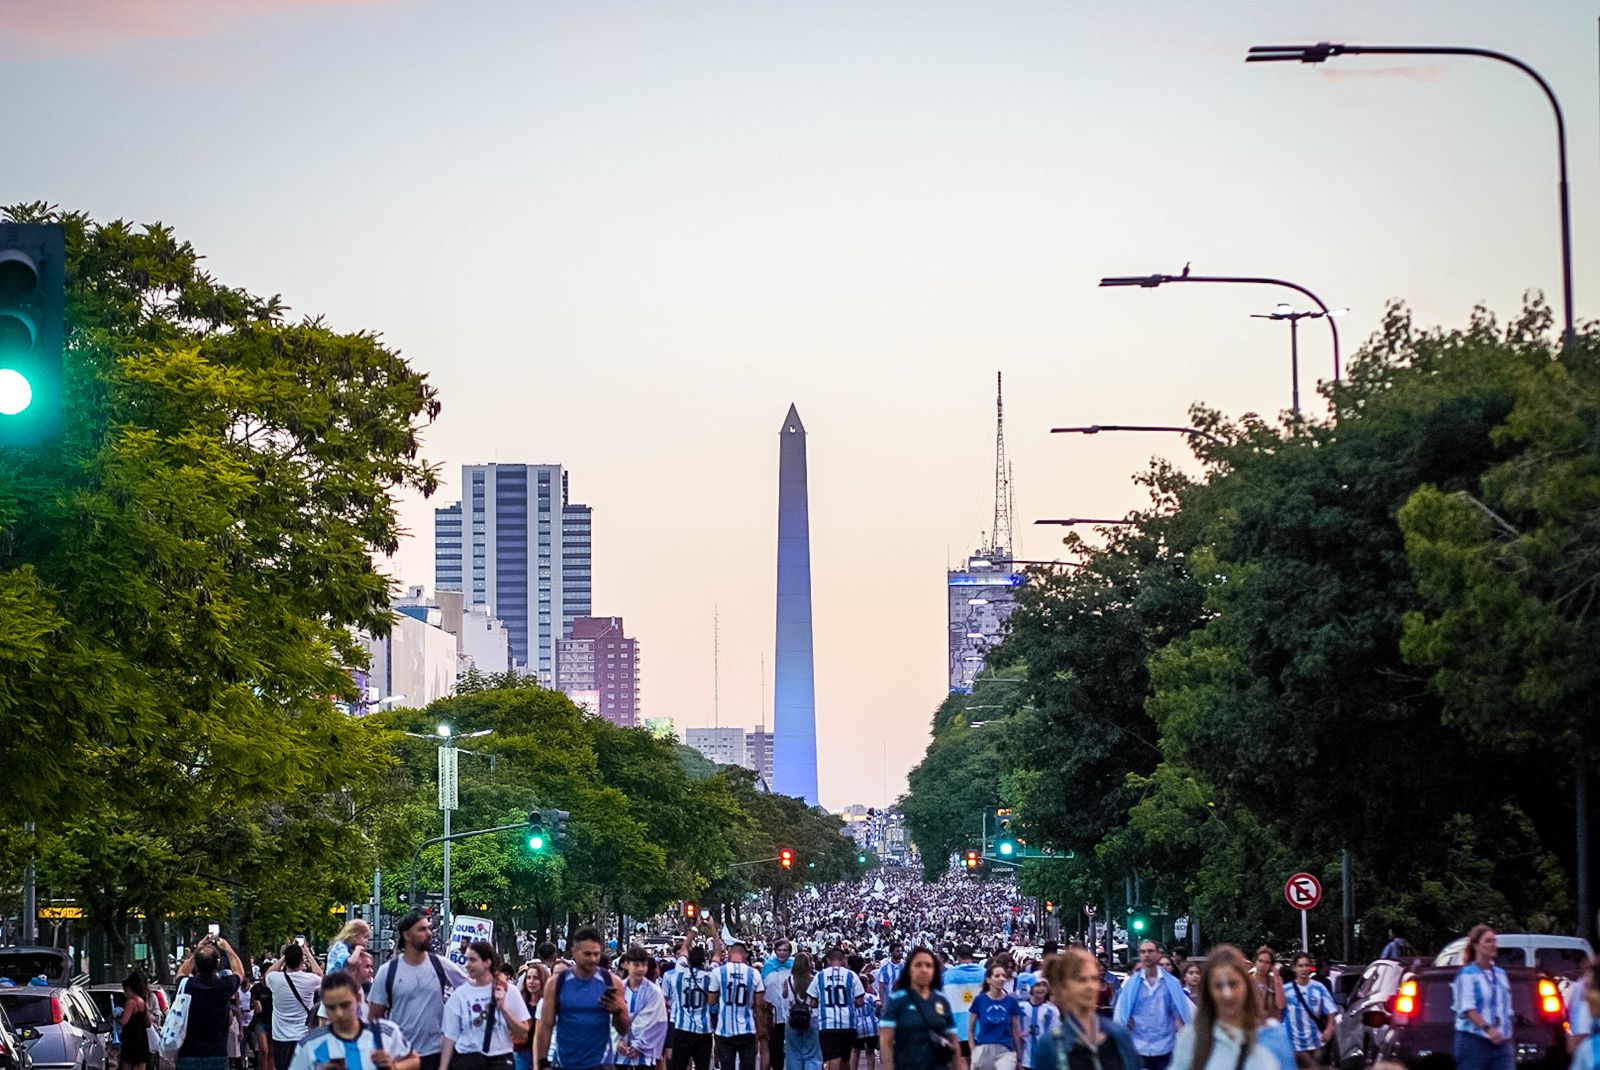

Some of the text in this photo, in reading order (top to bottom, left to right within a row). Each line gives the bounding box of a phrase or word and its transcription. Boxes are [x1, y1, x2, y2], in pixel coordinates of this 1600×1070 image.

[683, 987, 702, 1008] 10
[727, 982, 749, 1006] 10
[825, 985, 848, 1007] 10
